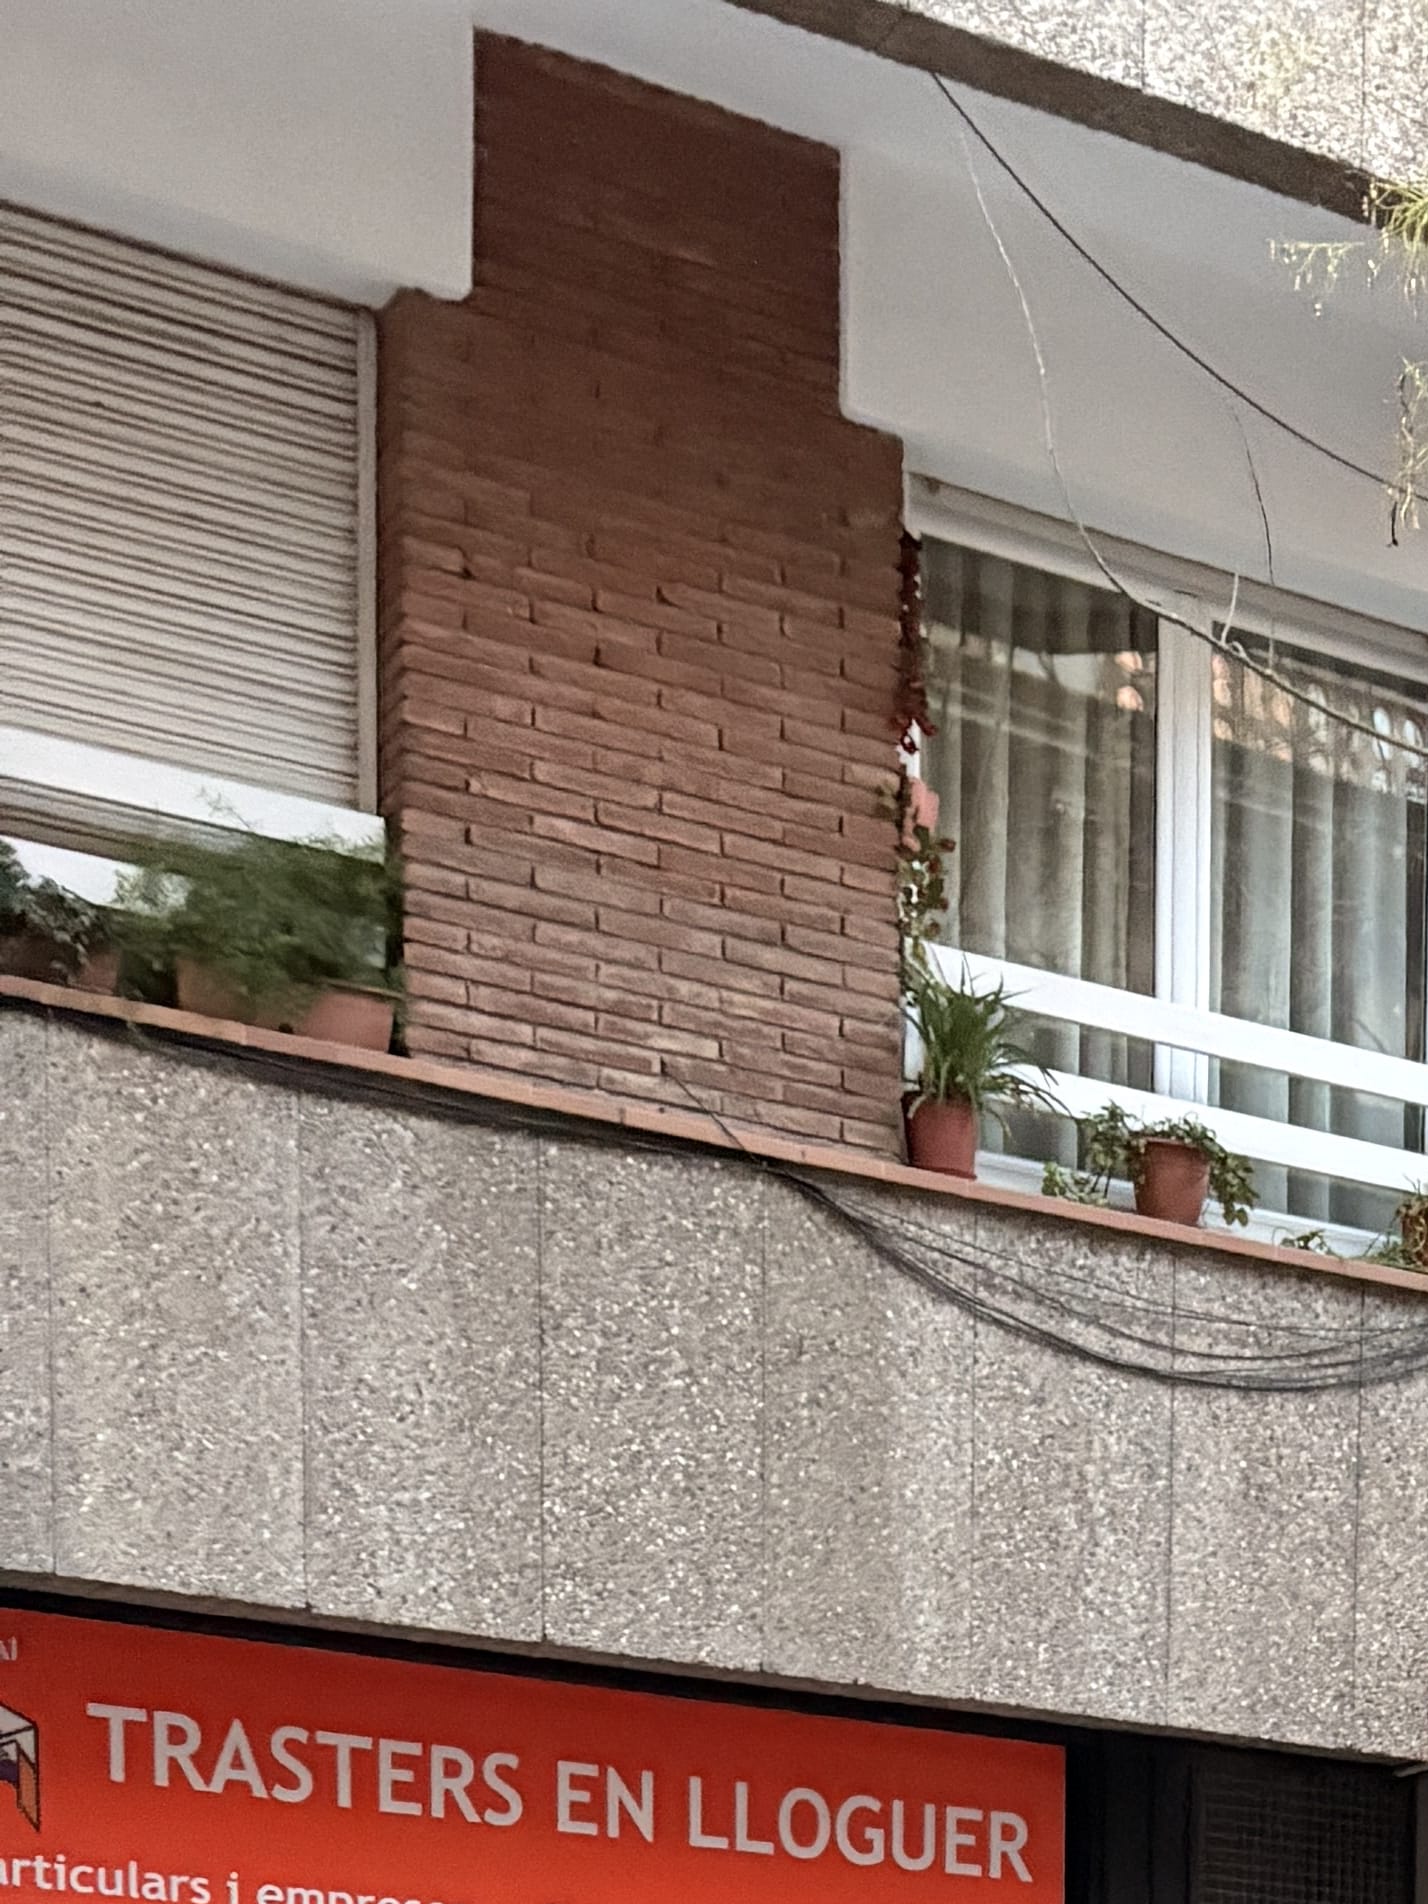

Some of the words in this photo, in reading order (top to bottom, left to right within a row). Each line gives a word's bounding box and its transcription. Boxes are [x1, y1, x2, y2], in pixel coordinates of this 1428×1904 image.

[86, 1702, 524, 1827] TRASTERS
[556, 1760, 654, 1843] EN
[688, 1775, 1033, 1883] LLOGUER
